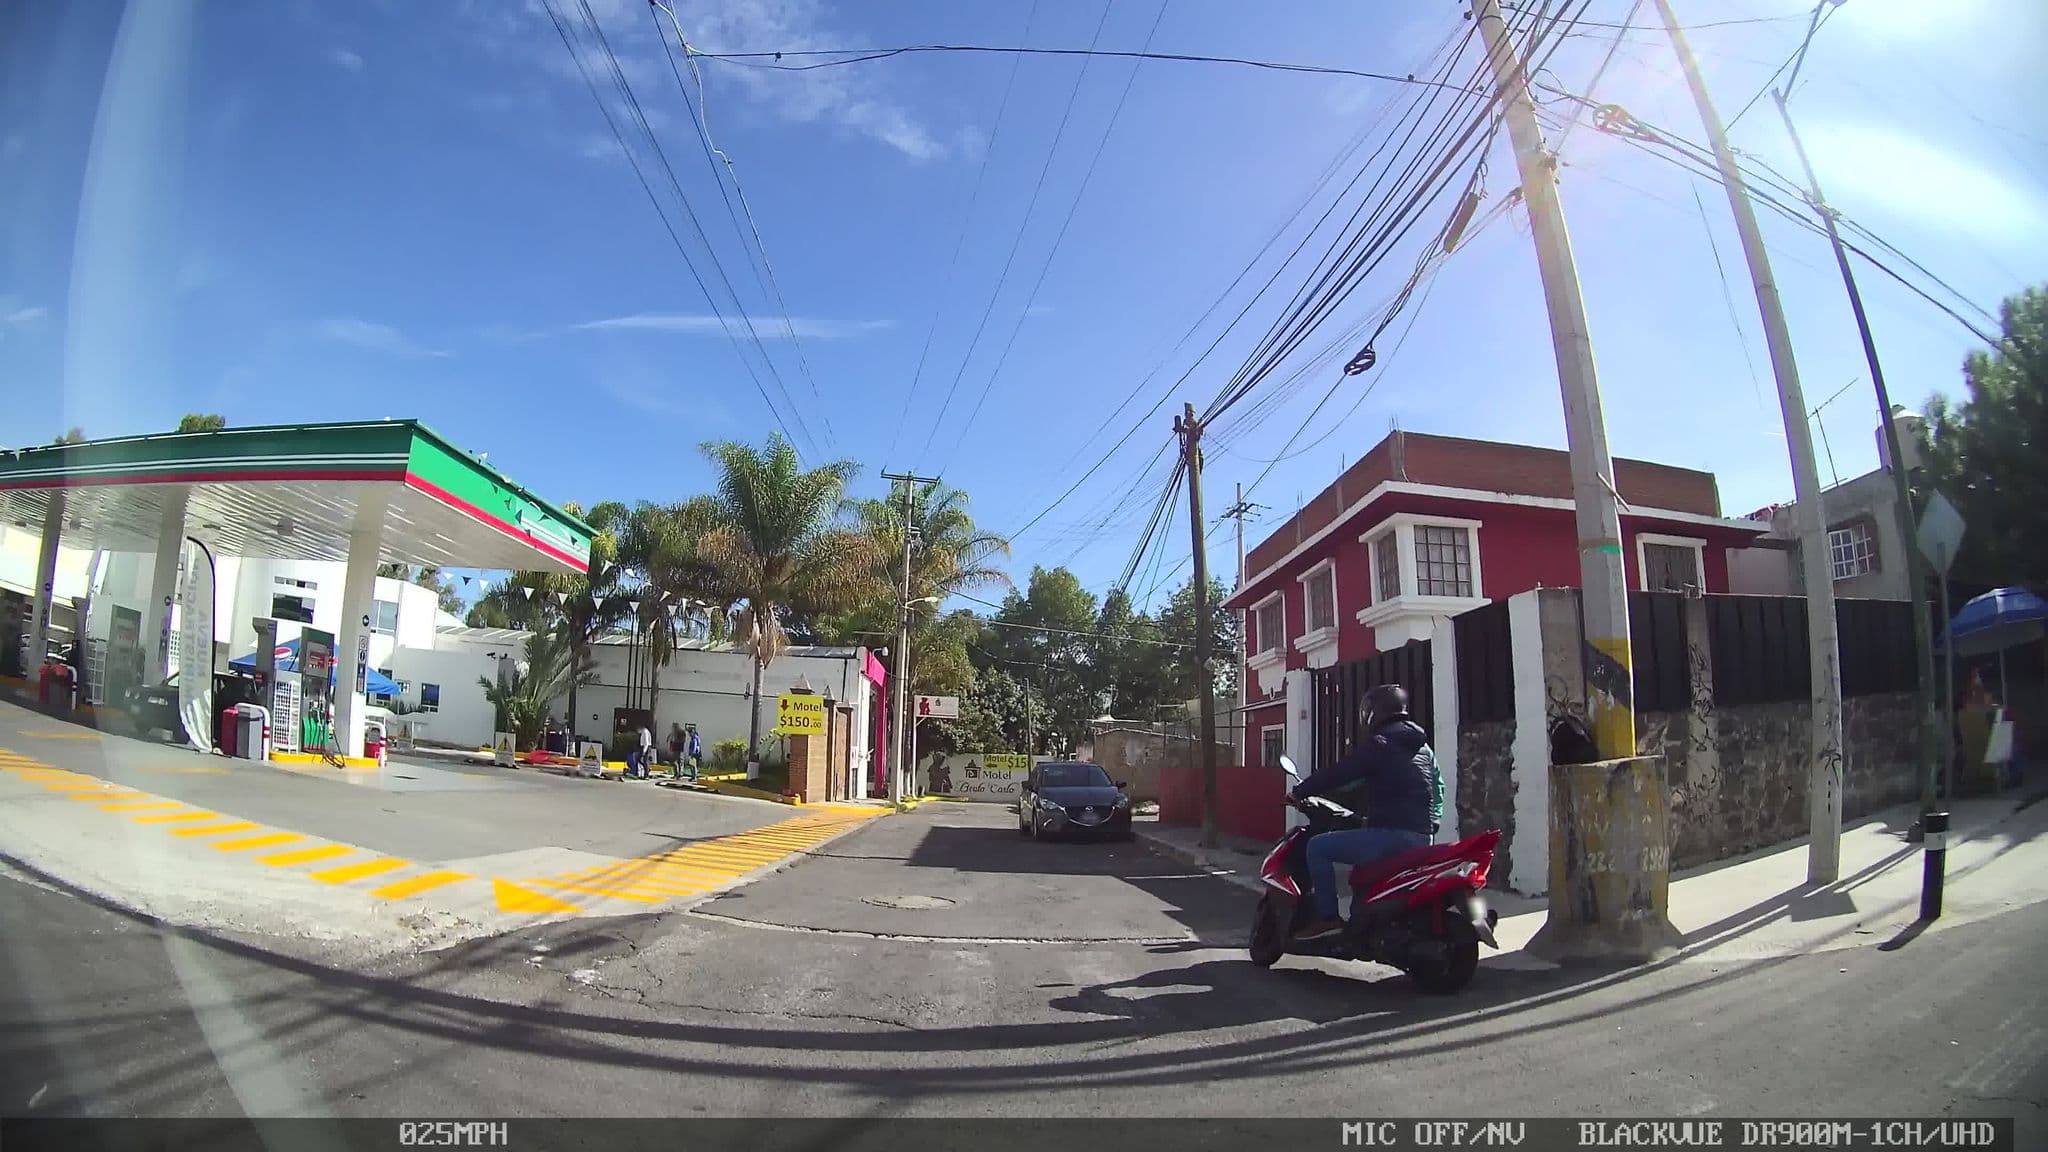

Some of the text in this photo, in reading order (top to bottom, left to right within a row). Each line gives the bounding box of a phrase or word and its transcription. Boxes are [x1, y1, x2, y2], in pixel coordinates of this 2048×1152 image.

[793, 702, 822, 712] Motel
[780, 713, 822, 728] $150.00
[983, 754, 1007, 763] Motel
[983, 770, 1011, 780] Motel
